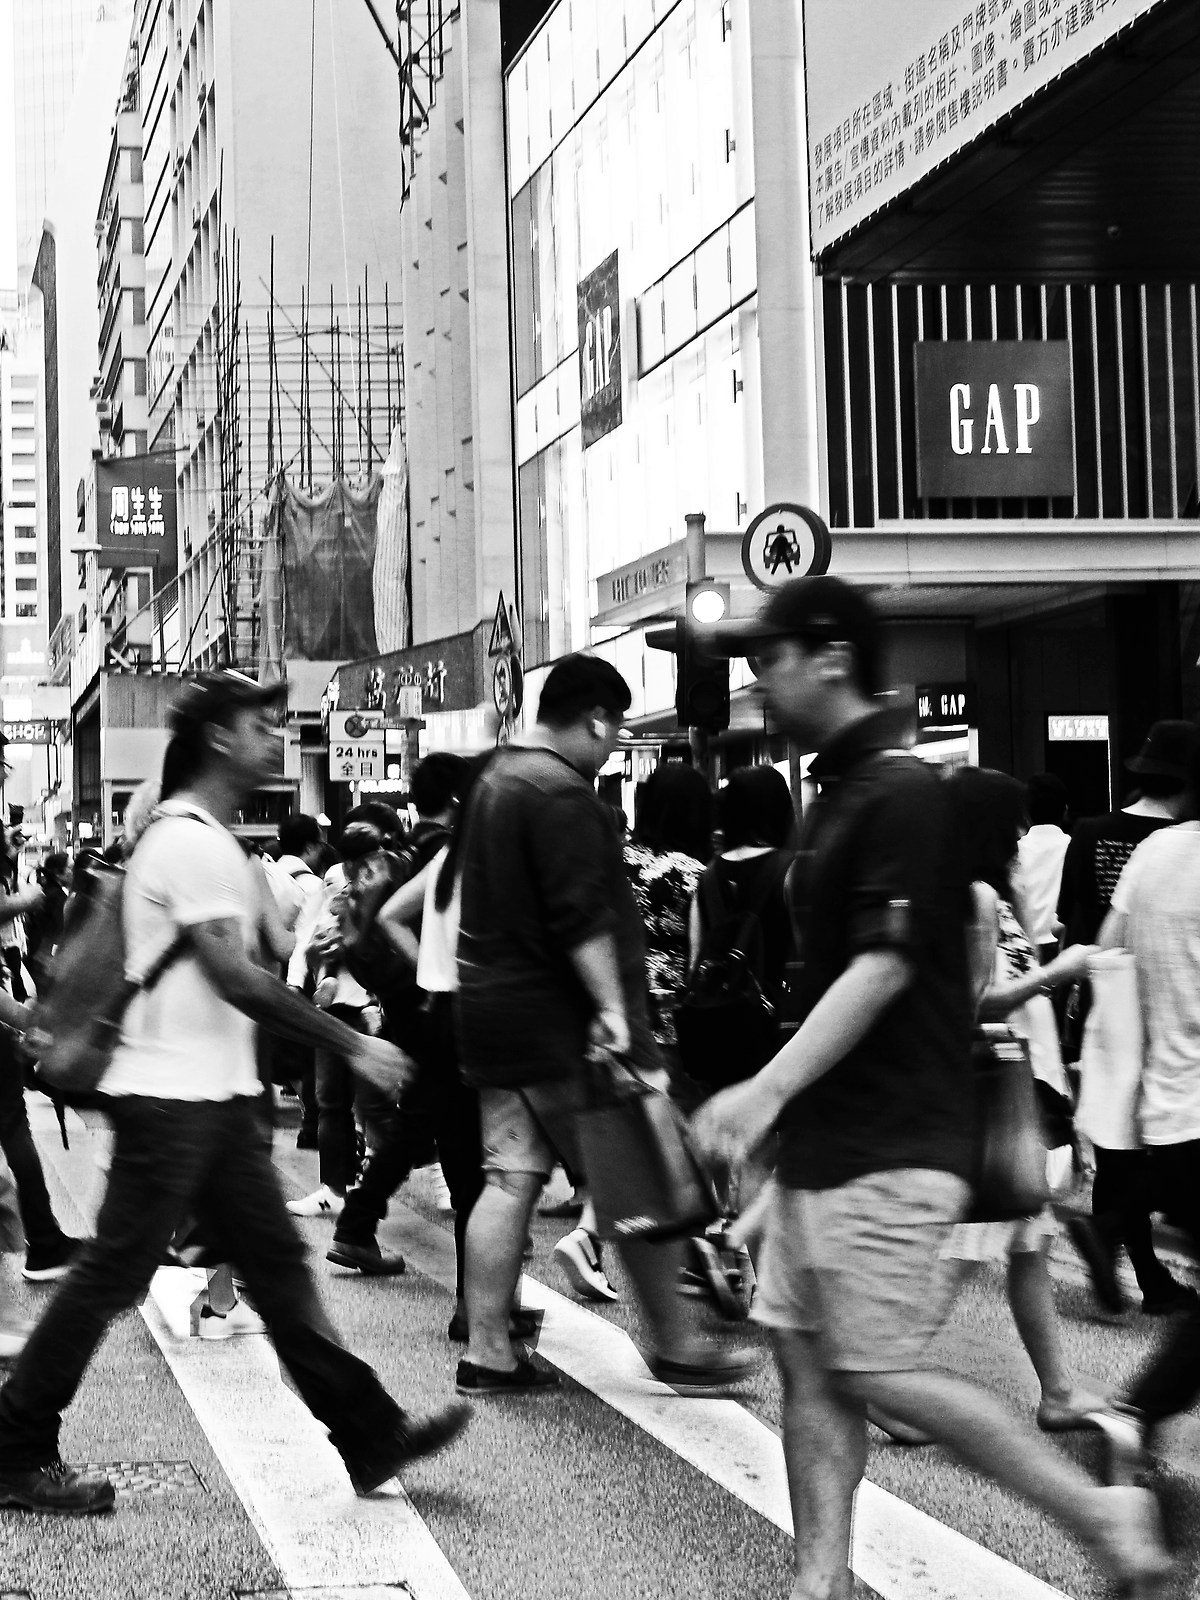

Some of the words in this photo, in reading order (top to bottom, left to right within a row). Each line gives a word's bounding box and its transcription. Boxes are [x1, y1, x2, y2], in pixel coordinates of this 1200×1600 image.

[949, 383, 1040, 455] GAP
[110, 485, 164, 521] 周生生
[940, 693, 966, 716] GAP
[335, 747, 354, 758] 24
[357, 746, 378, 758] hrs
[341, 761, 373, 777] 全日
